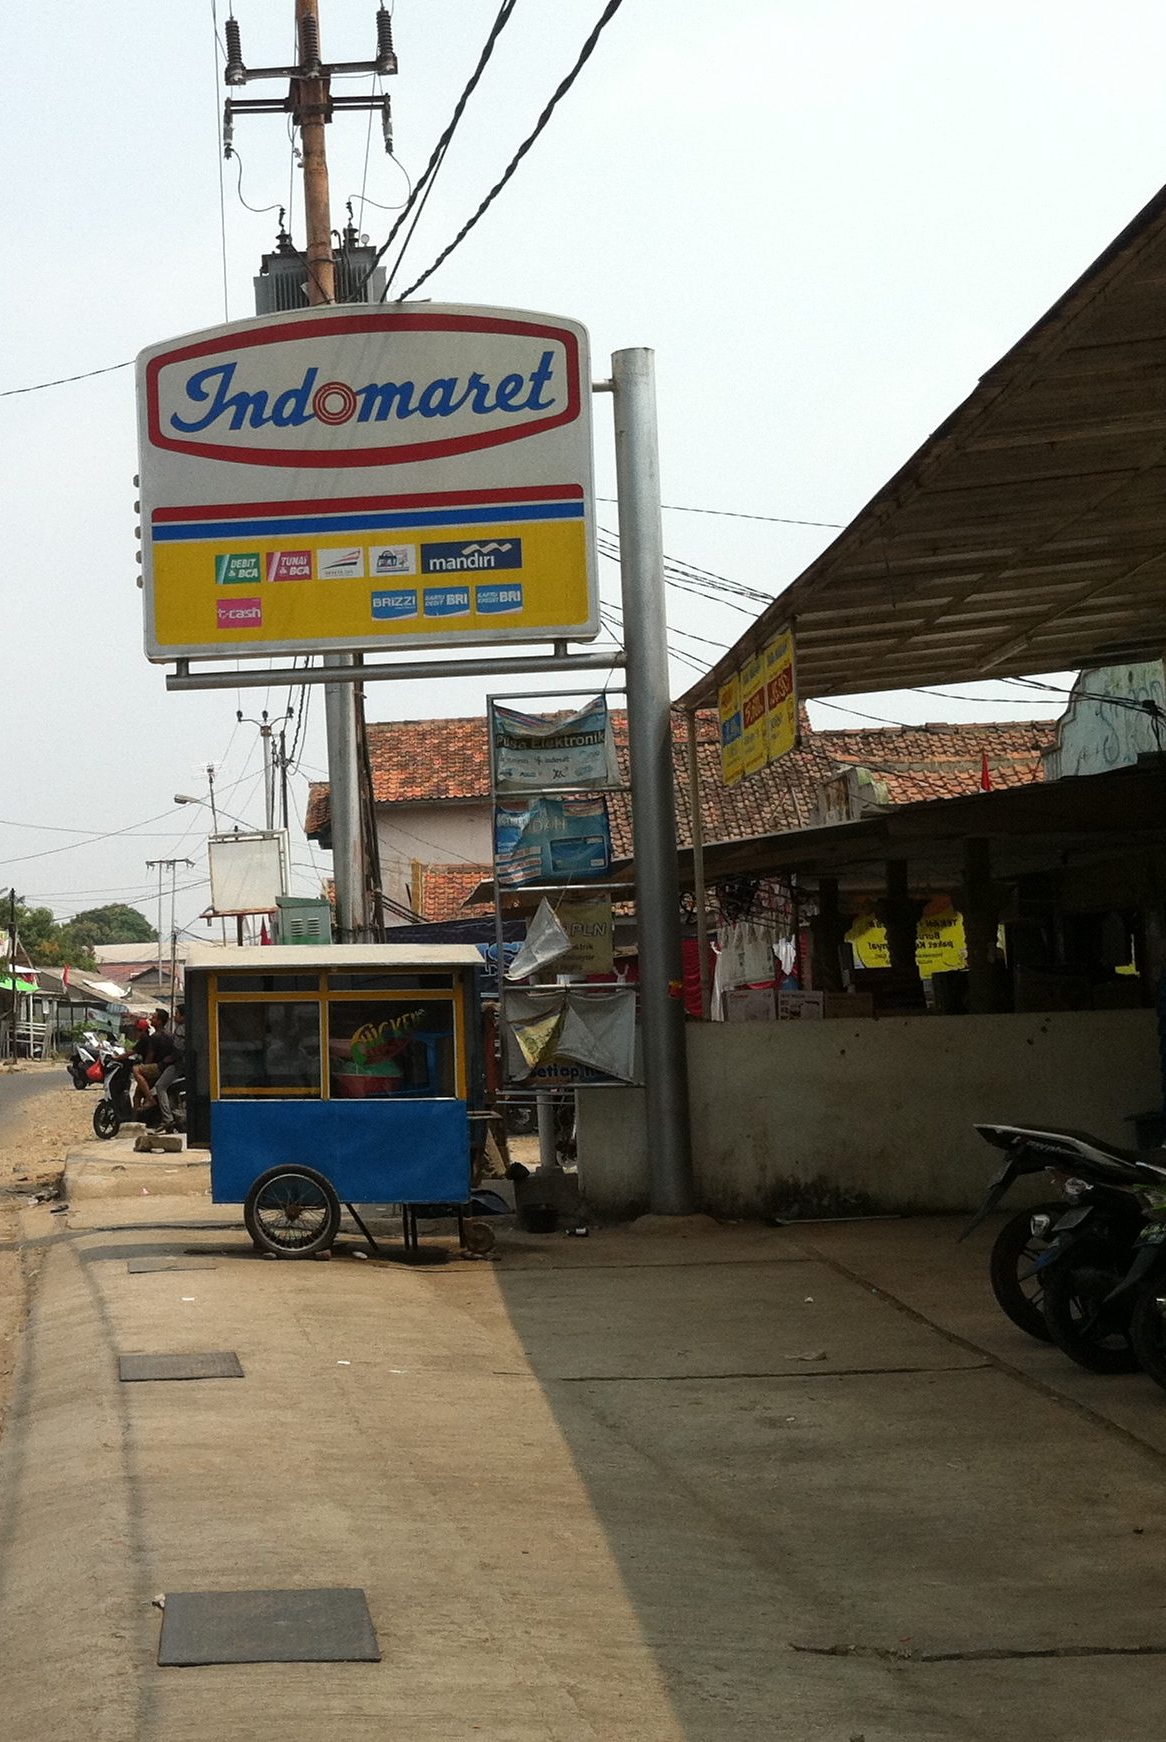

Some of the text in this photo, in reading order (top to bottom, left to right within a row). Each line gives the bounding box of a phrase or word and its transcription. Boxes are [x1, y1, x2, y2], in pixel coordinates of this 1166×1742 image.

[170, 351, 556, 433] Indomaret
[230, 558, 256, 568] DEBIT
[281, 555, 308, 566] TUNAI
[429, 552, 495, 570] mandiri
[238, 568, 259, 578] BCA
[289, 566, 310, 576] BCA
[373, 595, 416, 608] BRIZZI
[446, 593, 468, 605] BRI
[499, 590, 521, 602] BRI
[531, 732, 605, 748] Elektronik
[571, 922, 607, 937] PLN
